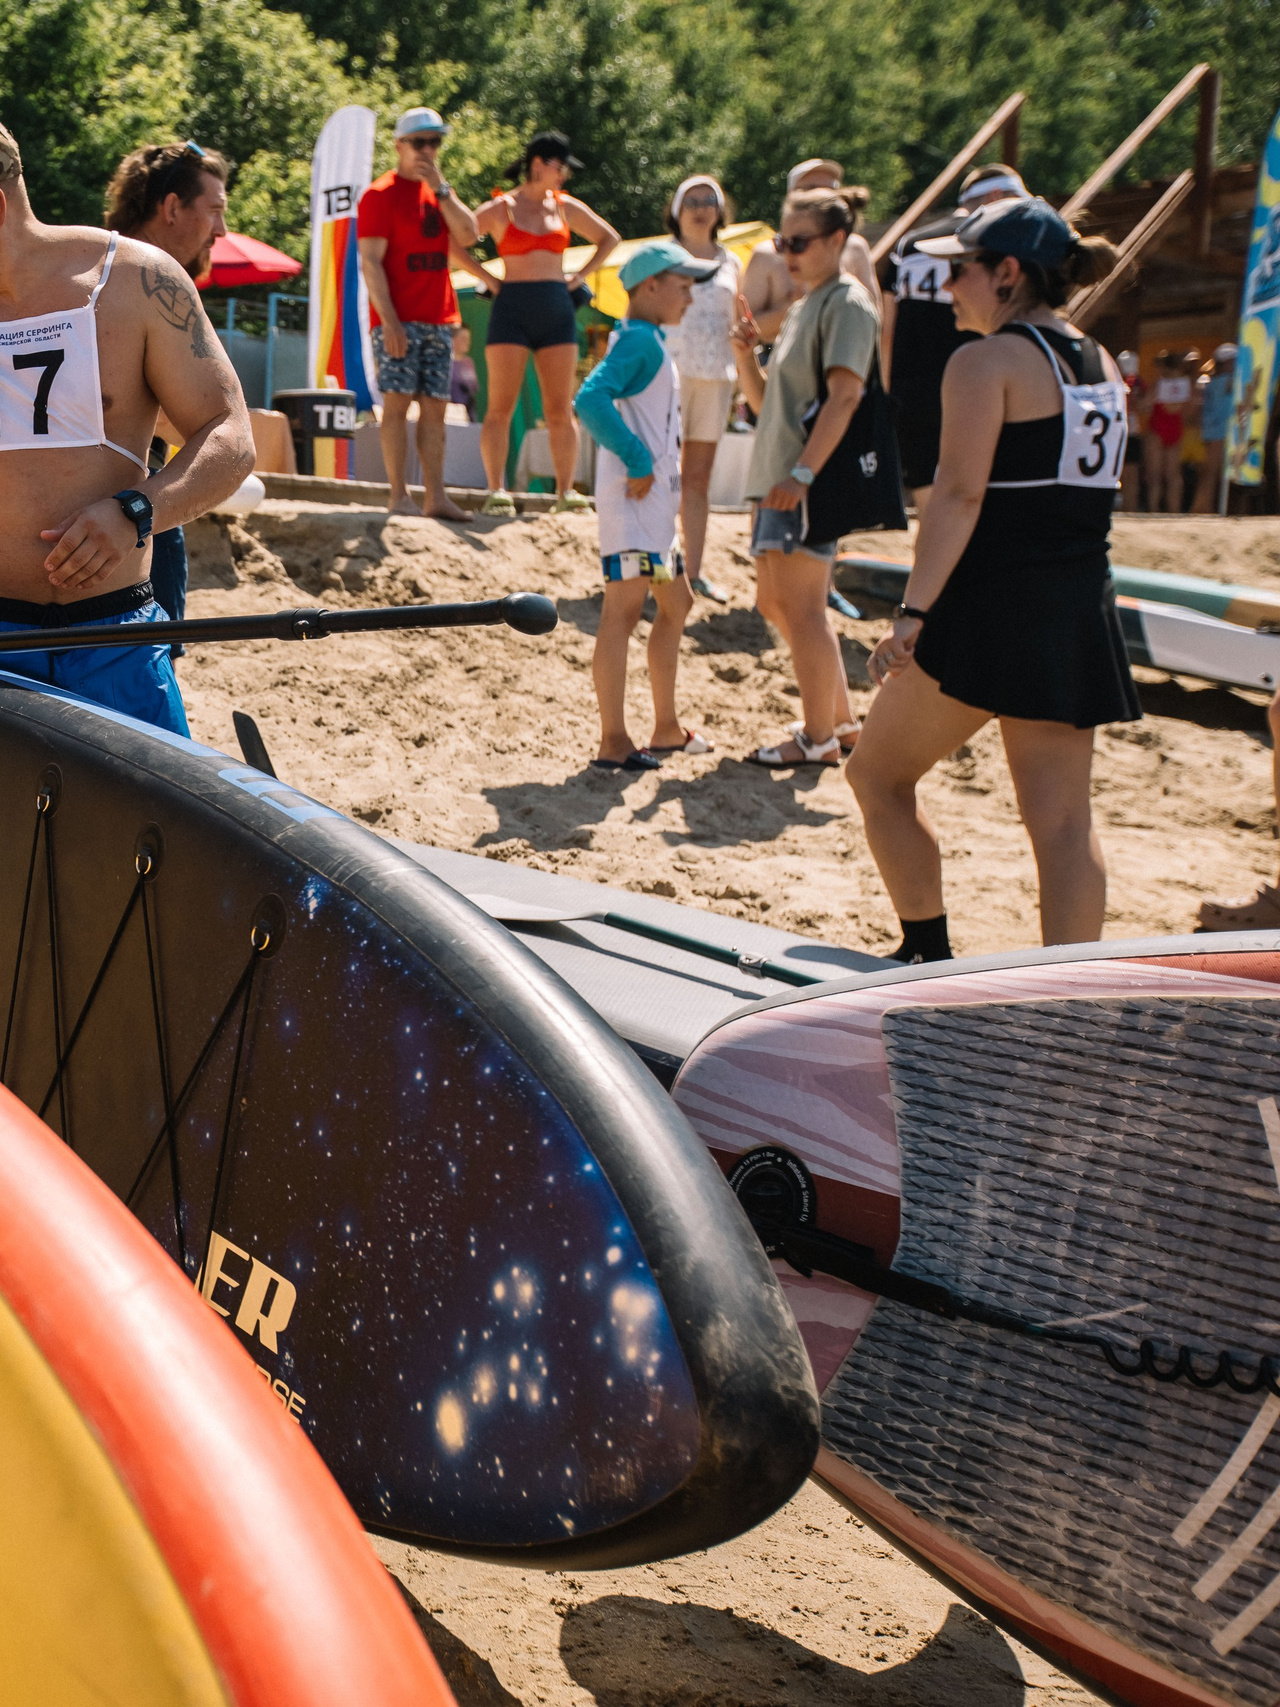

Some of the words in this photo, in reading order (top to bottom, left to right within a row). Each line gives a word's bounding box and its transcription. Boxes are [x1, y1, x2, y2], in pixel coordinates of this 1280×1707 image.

[903, 265, 938, 302] 14
[26, 322, 73, 337] СЕРФИНГА
[34, 332, 61, 343] ОБЛАСТИ
[787, 1158, 807, 1189] Inflatable
[802, 1190, 810, 1213] Stand
[194, 1230, 297, 1355] ER
